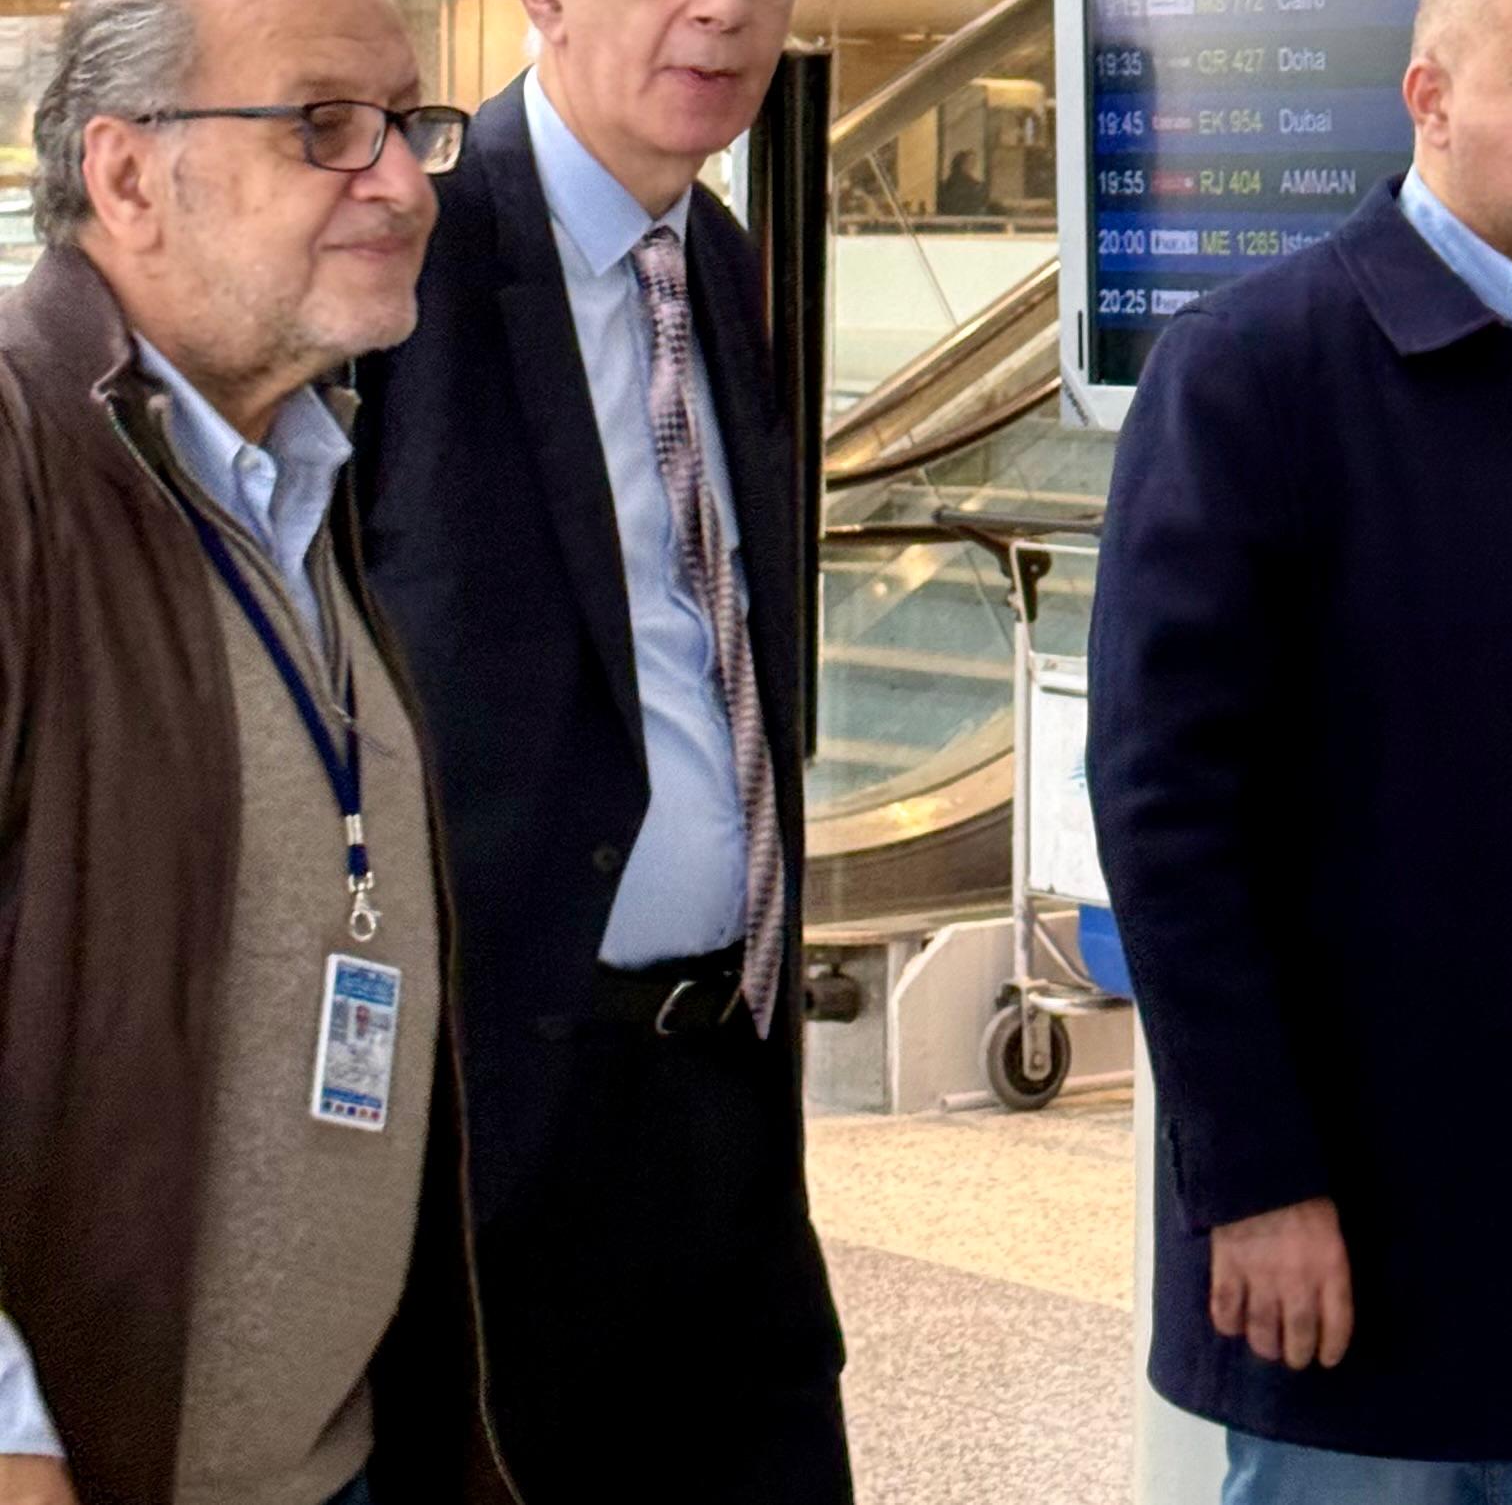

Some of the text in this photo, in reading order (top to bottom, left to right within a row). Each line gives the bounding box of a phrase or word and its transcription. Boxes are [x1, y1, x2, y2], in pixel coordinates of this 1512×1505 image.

[1278, 47, 1327, 73] Doha
[1098, 111, 1145, 136] 19:45
[1198, 109, 1225, 135] EK
[1279, 107, 1333, 135] Dubai
[1098, 169, 1145, 195] 19:55
[1199, 169, 1225, 196] RJ
[1228, 168, 1263, 194] 404
[1279, 169, 1357, 196] AMMAN
[1098, 228, 1146, 255] 20:00
[1200, 231, 1232, 255] ME
[1099, 288, 1147, 315] 20:25
